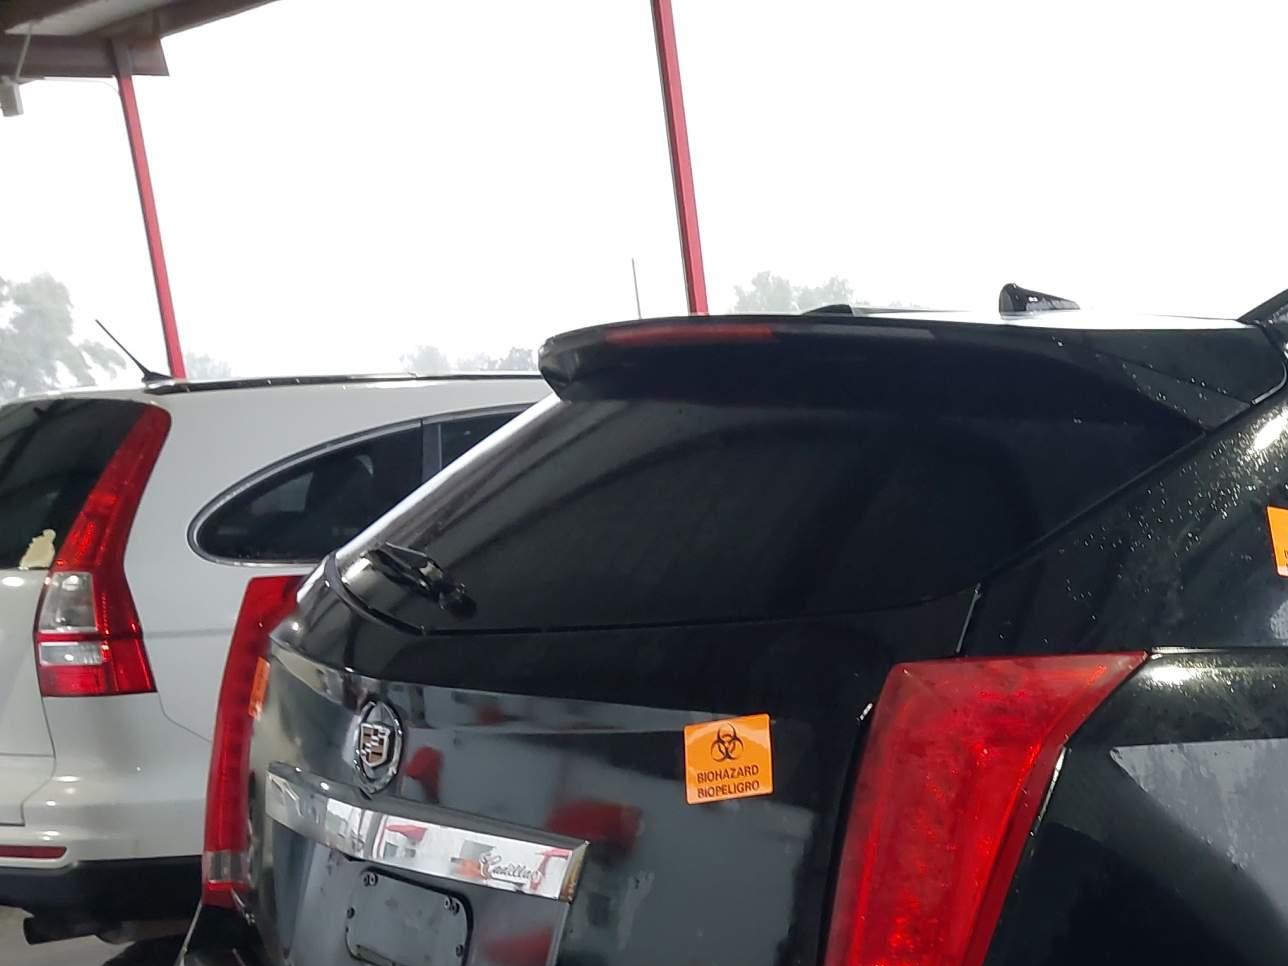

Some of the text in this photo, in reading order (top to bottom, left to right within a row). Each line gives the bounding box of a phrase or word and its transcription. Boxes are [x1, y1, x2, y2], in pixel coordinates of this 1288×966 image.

[697, 765, 759, 784] BIOHAZARD
[697, 780, 760, 799] BIOPELIGRO
[479, 853, 541, 880] Cadillac
